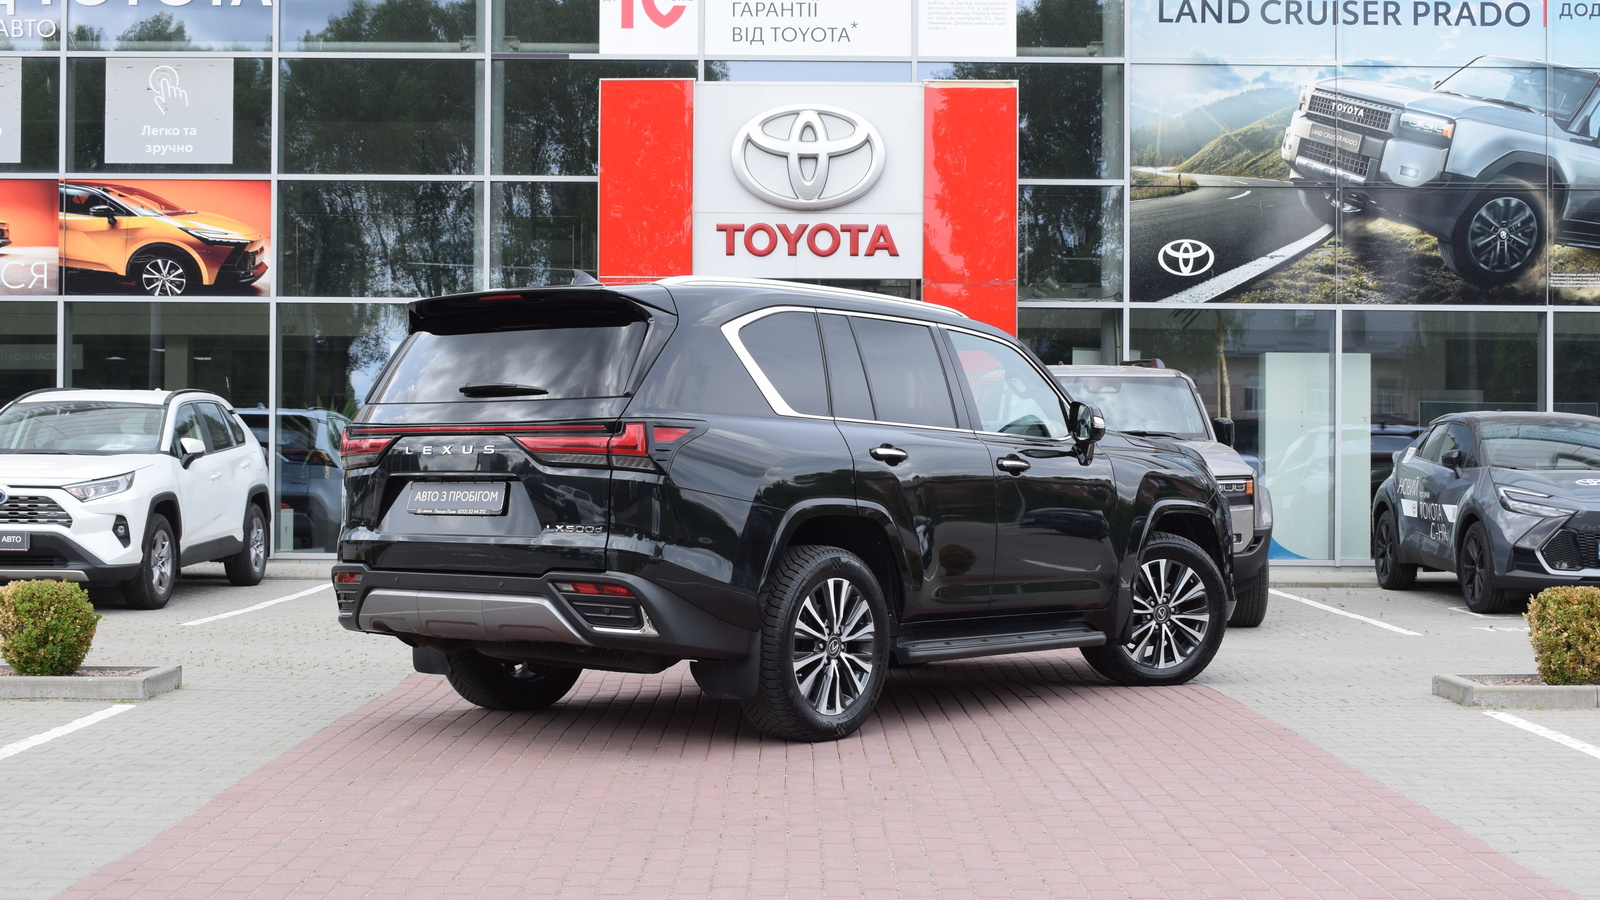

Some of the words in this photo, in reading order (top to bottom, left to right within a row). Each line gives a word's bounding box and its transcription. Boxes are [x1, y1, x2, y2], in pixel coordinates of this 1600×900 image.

[1158, 0, 1250, 24] LAND
[1260, 0, 1402, 26] CRUISER
[1412, 1, 1531, 28] PRADO
[0, 19, 56, 38] АВТО
[732, 27, 765, 45] ВІД
[1331, 102, 1364, 117] TOYOTA
[141, 125, 180, 136] Легко
[183, 127, 197, 136] та
[1310, 128, 1323, 137] LAND
[1323, 131, 1342, 142] CRUISER
[1342, 136, 1358, 147] PRADO
[145, 144, 193, 156] зручно
[716, 223, 899, 257] TOYOTA
[1, 261, 48, 289] СЯ
[405, 444, 496, 455] LEXUS
[1397, 476, 1420, 497] НОВИЙ
[414, 490, 440, 502] АВТО
[440, 490, 447, 502] З
[448, 490, 499, 502] ПРОБІГОМ
[1419, 501, 1444, 522] TOYOTA
[546, 524, 603, 534] LX500d
[1430, 522, 1449, 542] C-HR
[1, 535, 22, 543] АВТО
